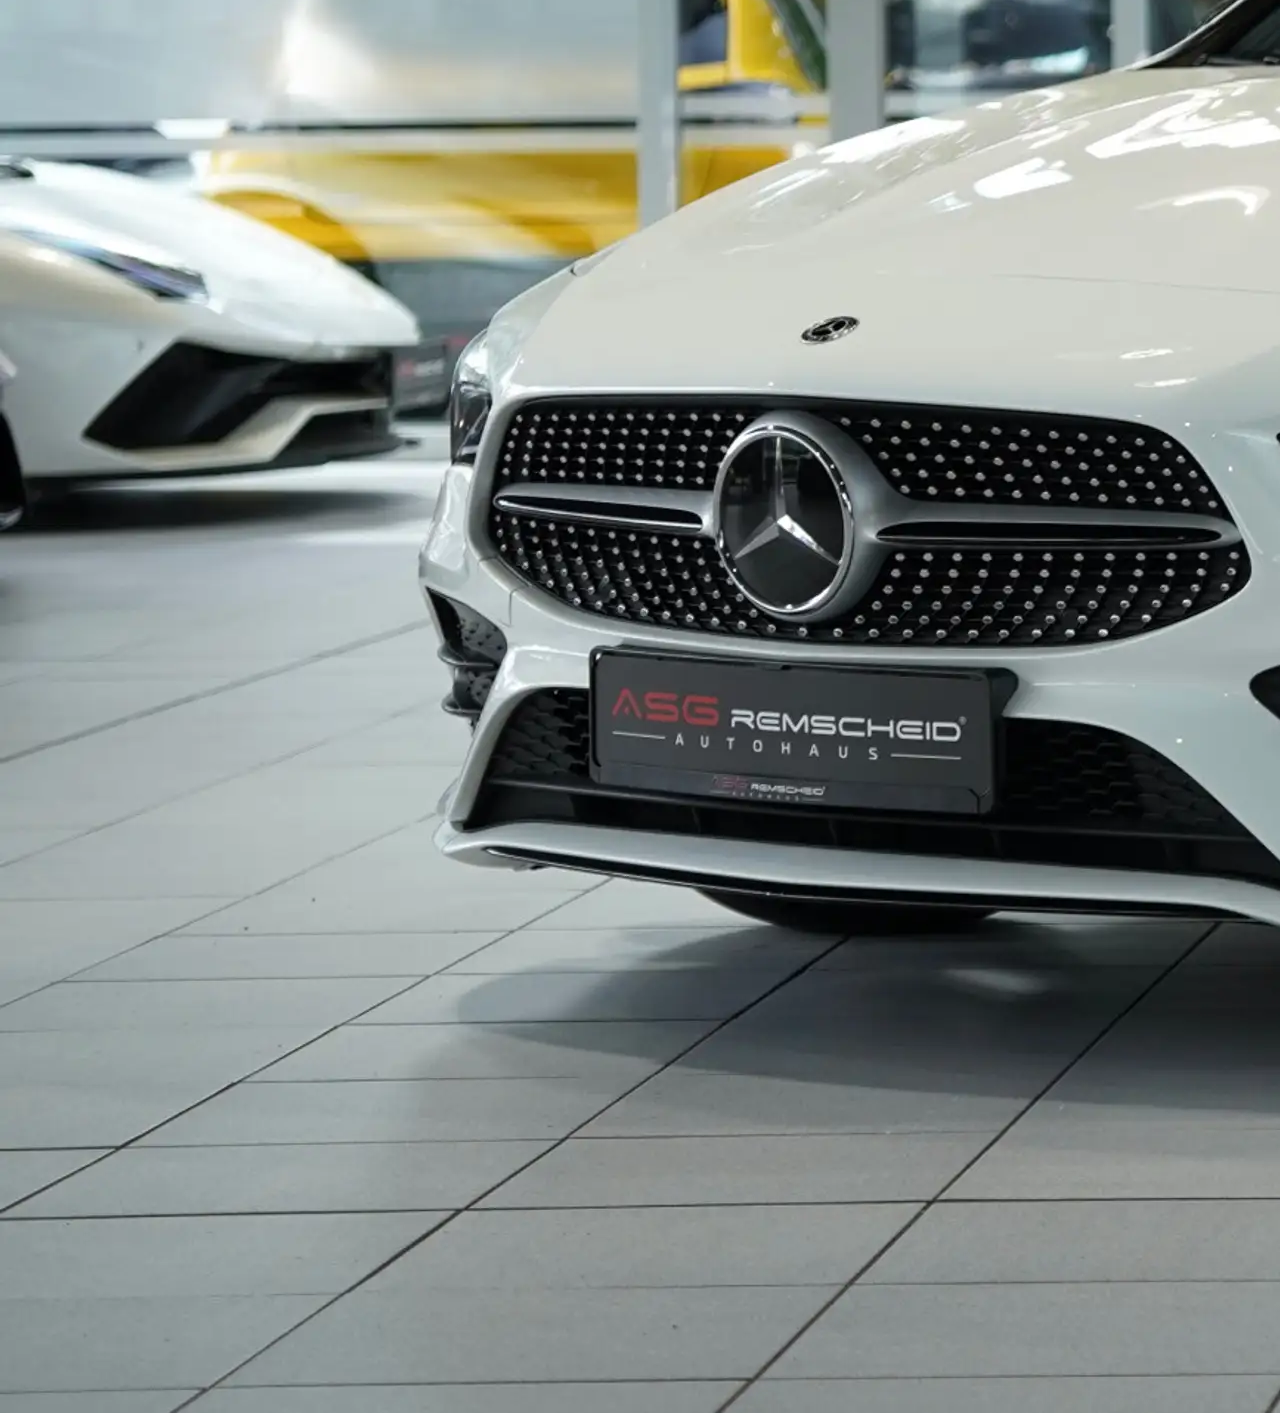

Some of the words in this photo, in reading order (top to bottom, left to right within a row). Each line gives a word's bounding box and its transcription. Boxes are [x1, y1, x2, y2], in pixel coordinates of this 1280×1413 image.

[612, 687, 720, 727] ASG
[730, 709, 962, 743] REMSCHEID
[675, 733, 880, 761] AUTOHAUS
